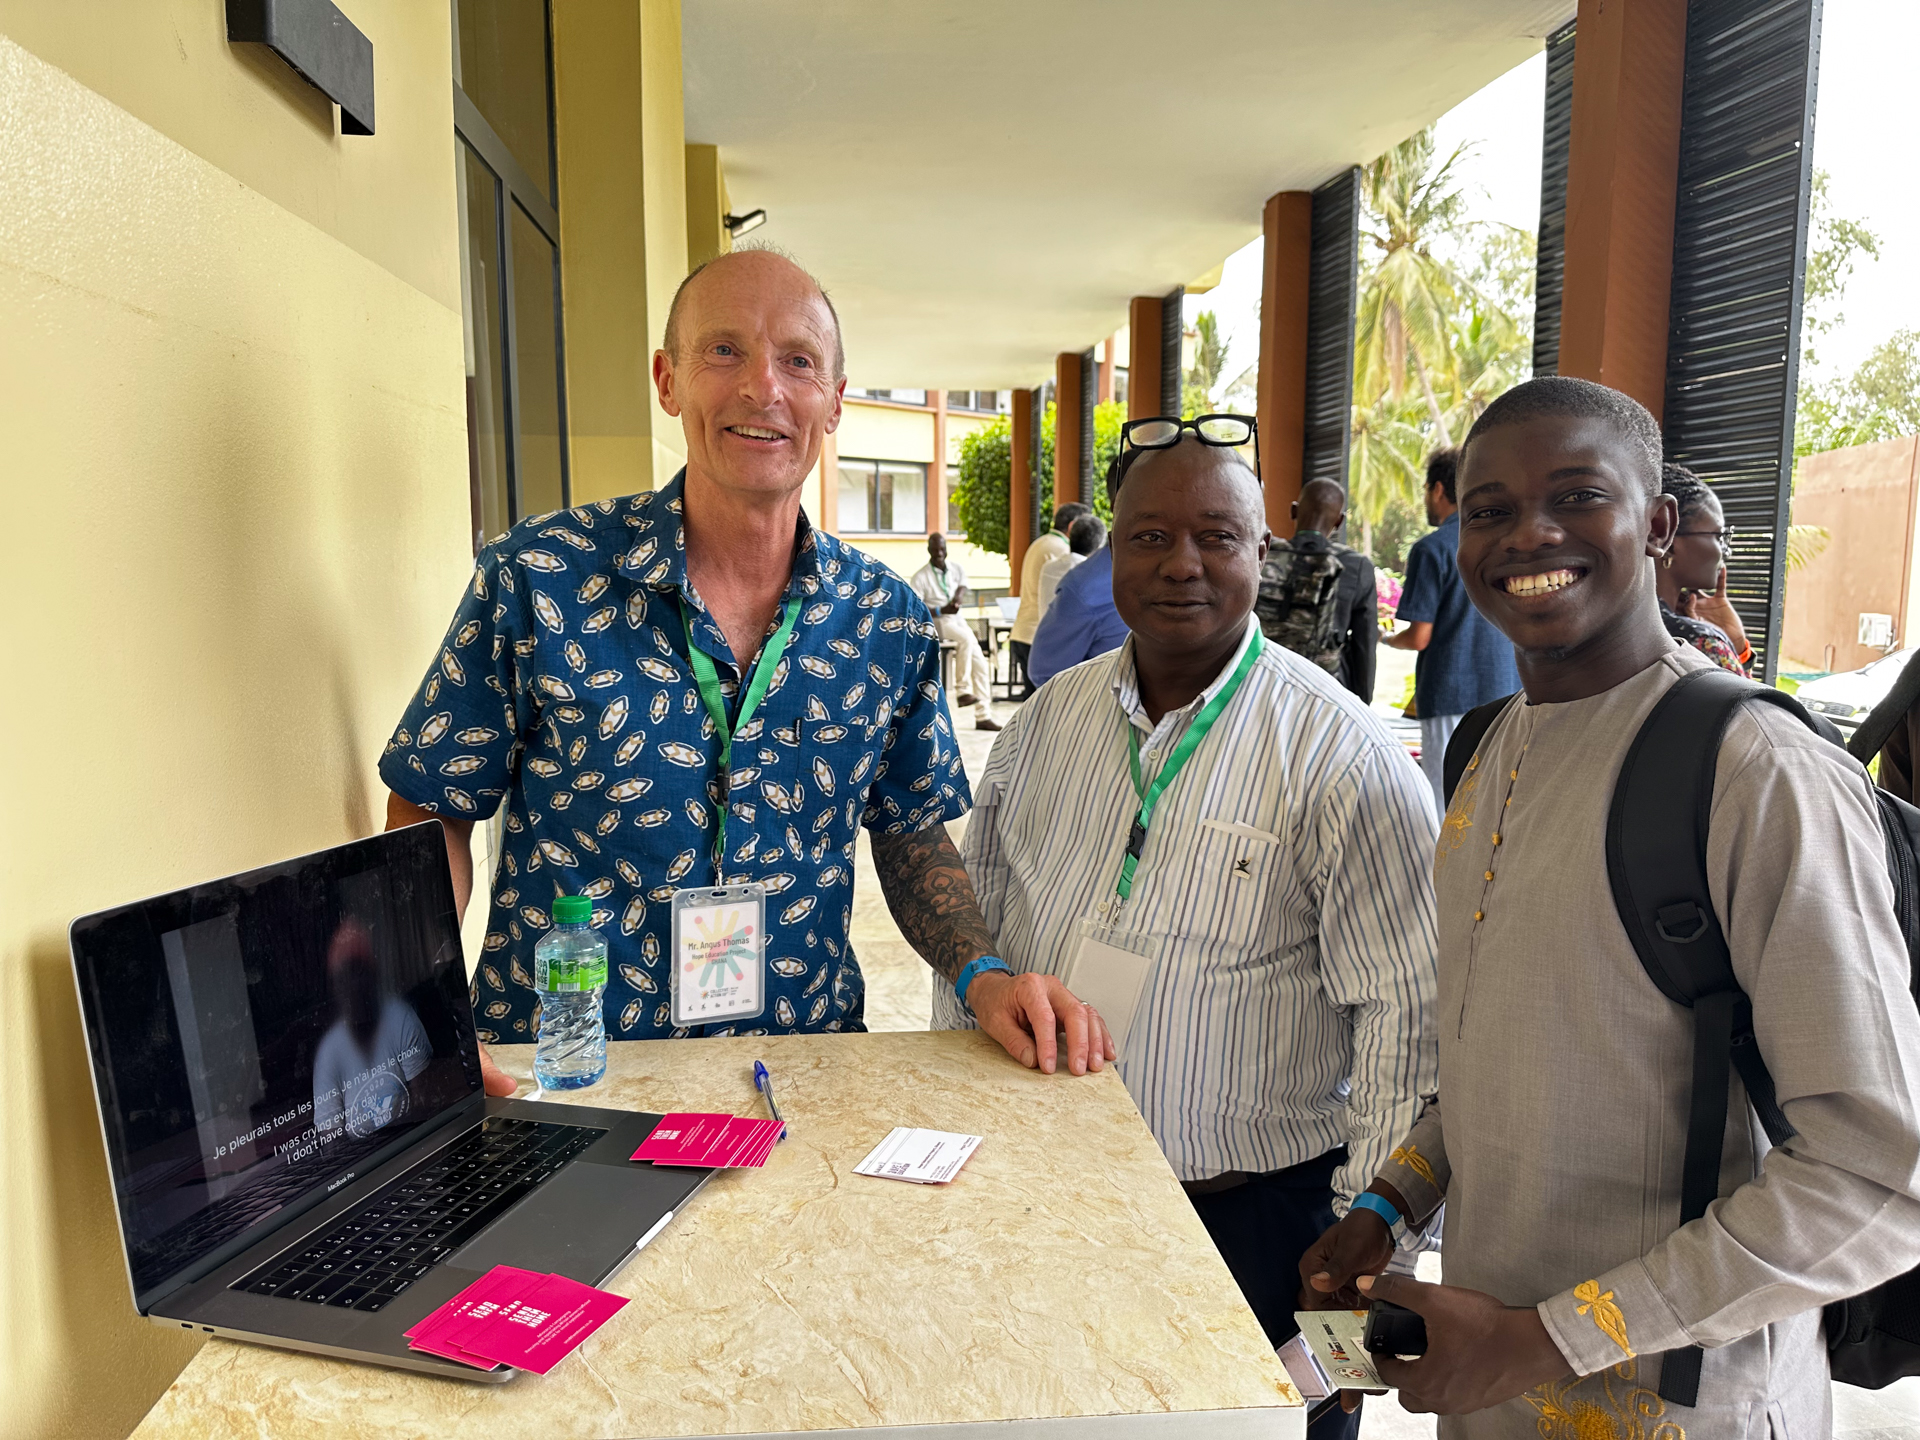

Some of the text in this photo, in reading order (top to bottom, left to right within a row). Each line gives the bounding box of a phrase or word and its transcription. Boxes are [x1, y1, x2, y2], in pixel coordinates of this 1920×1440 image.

[700, 941, 721, 950] Angus
[723, 938, 750, 946] Thomas
[213, 1045, 421, 1160] Je pleurais tous les jours. Je n'ai pas le choix.
[273, 1093, 380, 1157] I was crying every day.
[287, 1154, 291, 1165] I
[293, 1141, 318, 1162] don't
[320, 1127, 343, 1147] have
[327, 1172, 355, 1192] MacBook Pro
[467, 1301, 494, 1316] SEND
[508, 1306, 533, 1321] SEND
[517, 1308, 541, 1324] THEM
[527, 1312, 551, 1327] HOME
